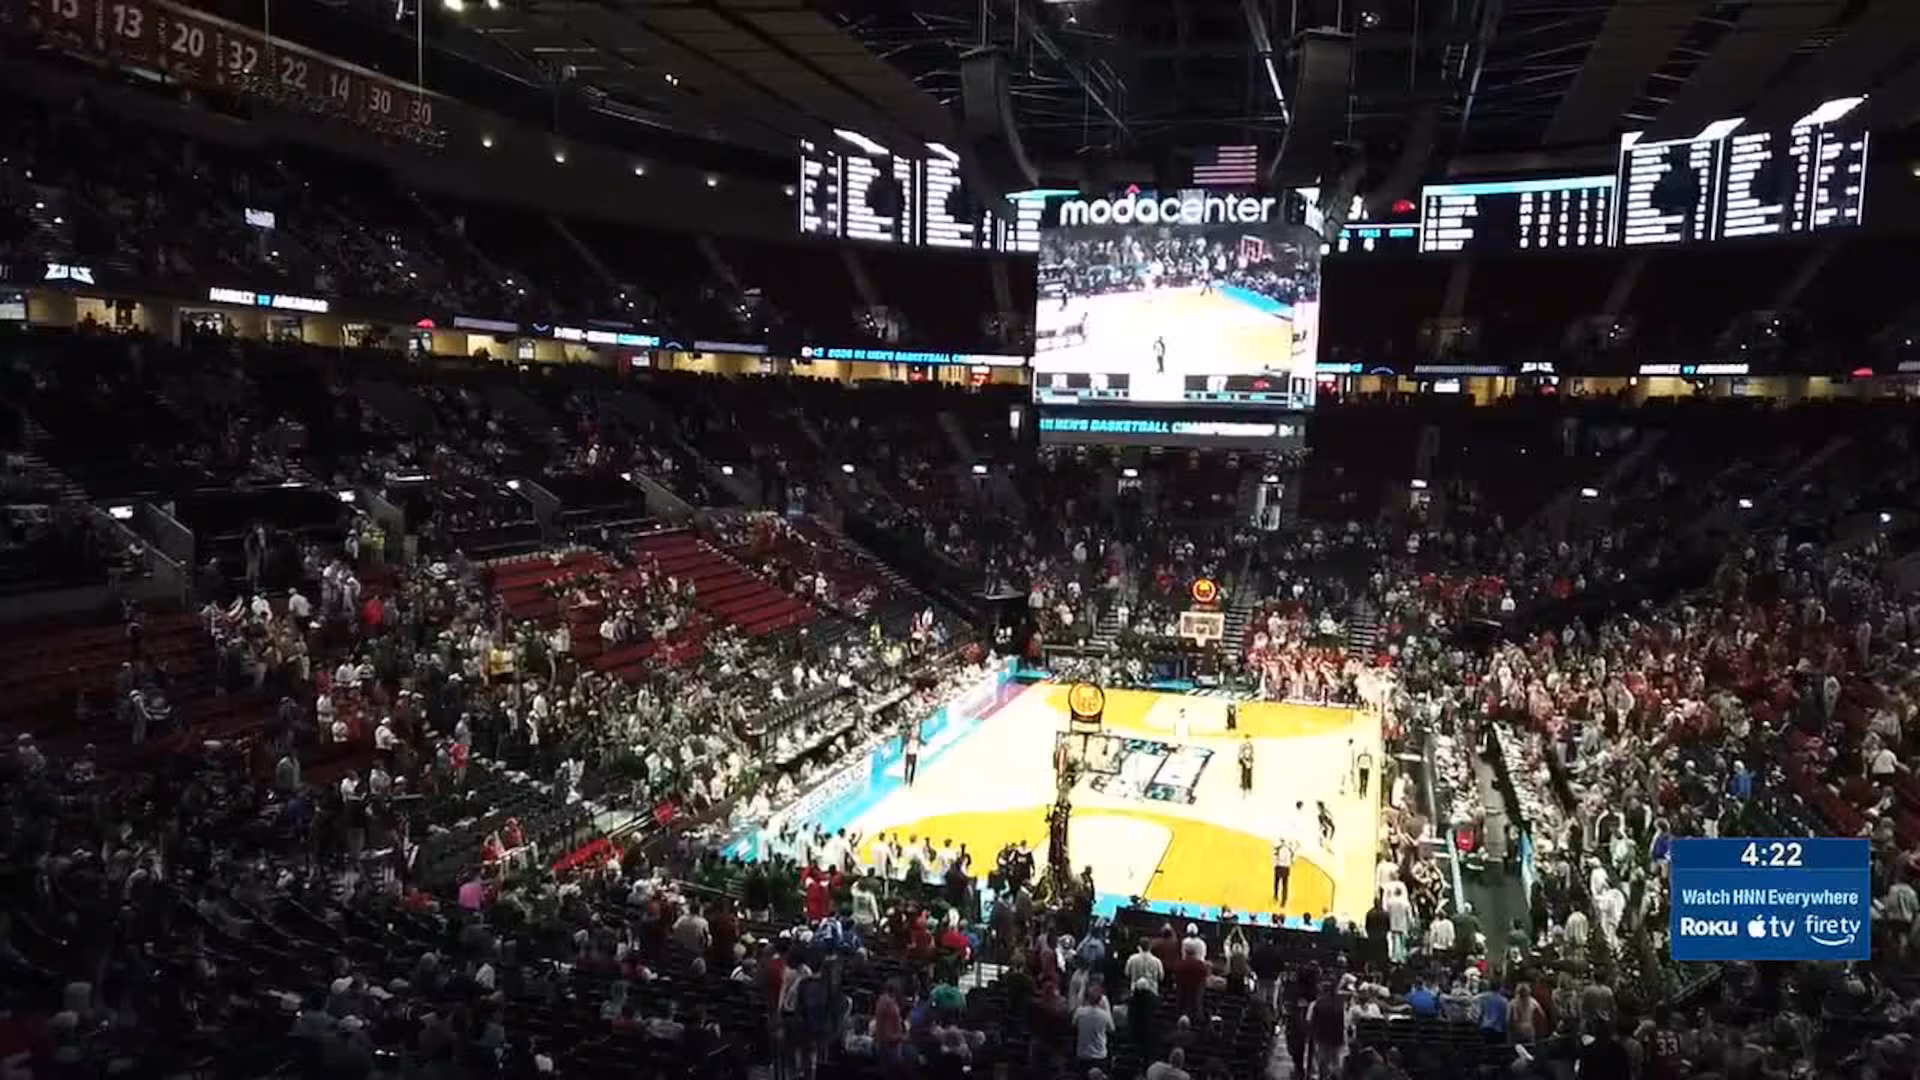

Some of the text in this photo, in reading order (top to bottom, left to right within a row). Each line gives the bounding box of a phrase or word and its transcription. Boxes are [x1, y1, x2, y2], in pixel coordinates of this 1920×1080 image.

[171, 23, 205, 57] 20
[229, 41, 258, 74] 32
[281, 57, 307, 88] 22
[330, 74, 350, 102] 14
[370, 86, 392, 114] 30
[411, 100, 432, 126] 30
[895, 352, 950, 363] BASKETBALL
[1090, 419, 1169, 433] BASKETBALL
[1656, 1037, 1679, 1056] 33
